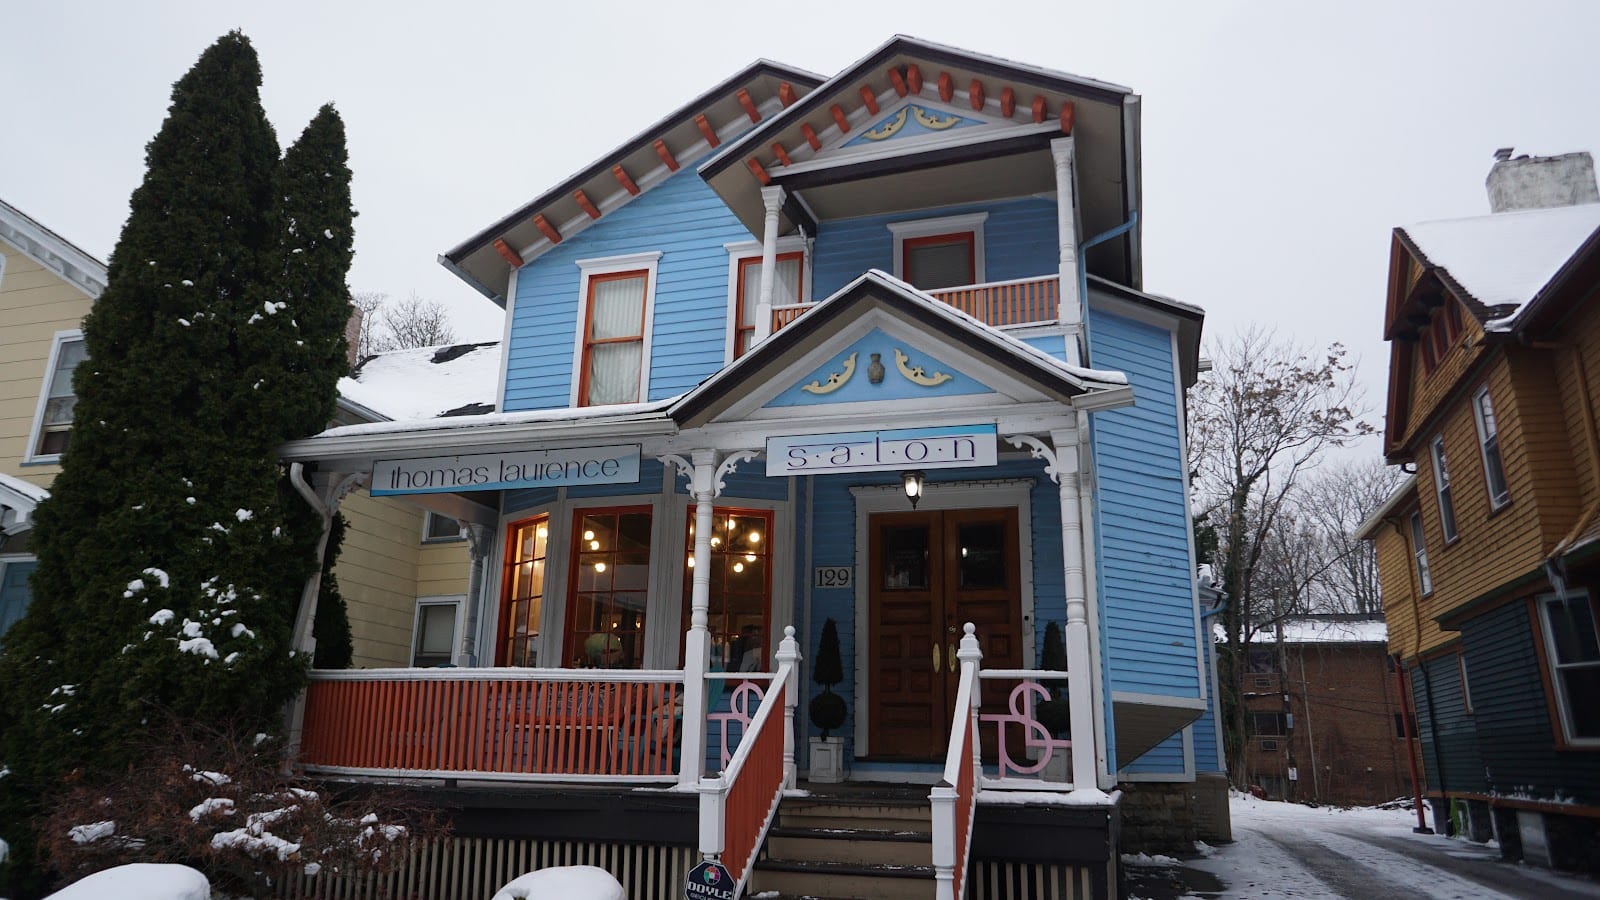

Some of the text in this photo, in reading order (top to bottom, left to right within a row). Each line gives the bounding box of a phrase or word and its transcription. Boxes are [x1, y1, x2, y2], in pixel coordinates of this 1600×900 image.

[390, 458, 620, 489] thomas laurence
[815, 568, 849, 587] 129
[687, 881, 732, 900] DOYLE
